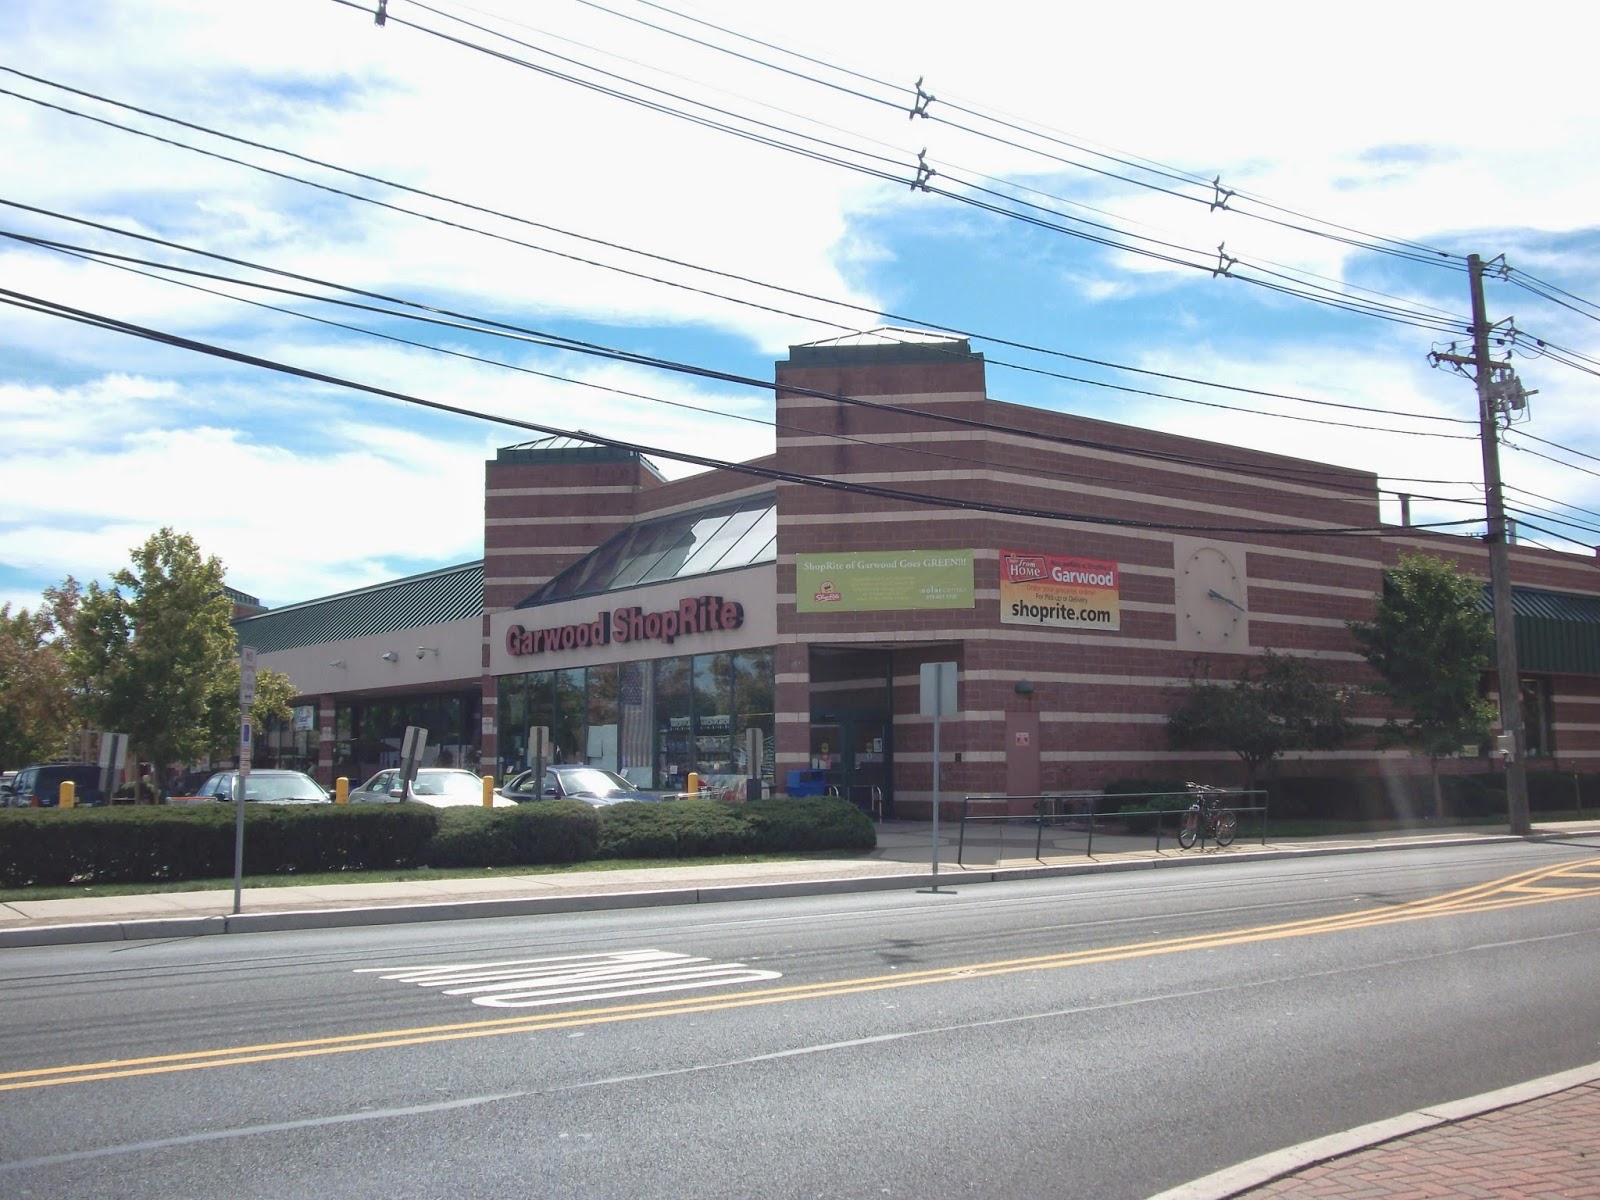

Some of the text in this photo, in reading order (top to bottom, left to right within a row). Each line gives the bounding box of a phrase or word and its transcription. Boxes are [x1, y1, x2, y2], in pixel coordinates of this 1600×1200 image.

[804, 561, 843, 573] ShopRite
[846, 560, 856, 570] of
[857, 559, 897, 570] Garwood
[899, 558, 921, 568] Goes
[1018, 559, 1036, 567] from
[1052, 566, 1114, 587] Garwood
[1068, 595, 1088, 605] Delivery
[1011, 599, 1110, 622] shoprite.com
[506, 595, 744, 656] Garwood ShopRite
